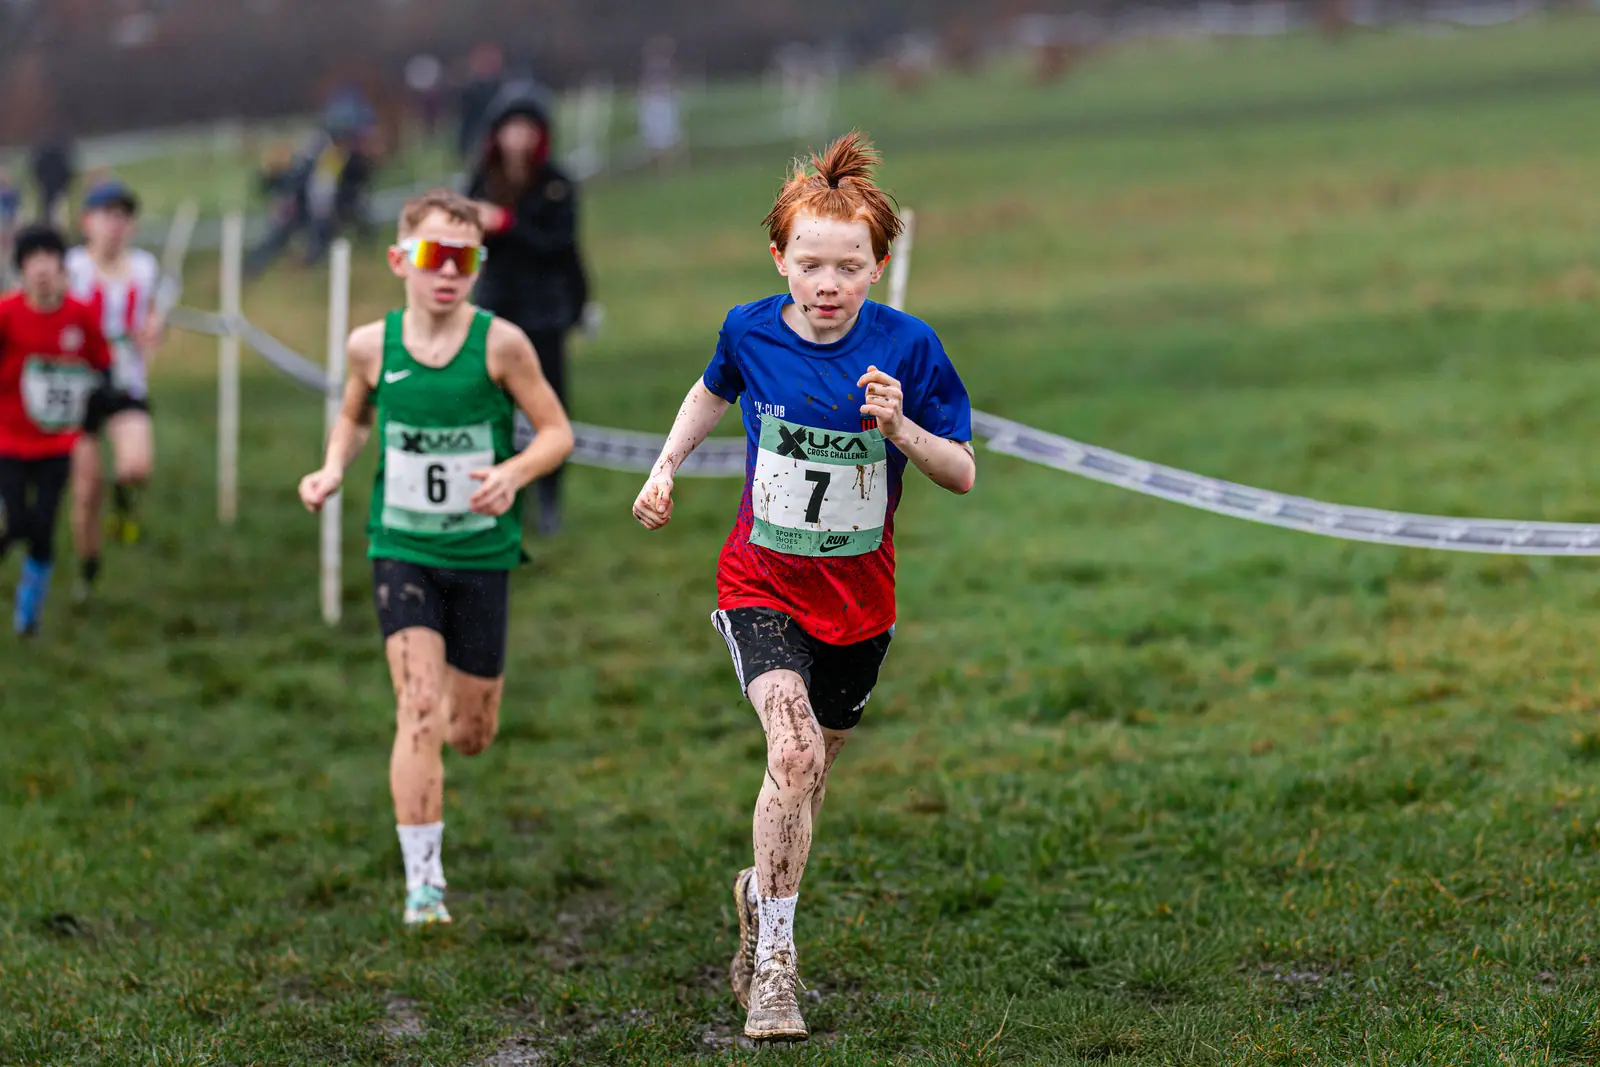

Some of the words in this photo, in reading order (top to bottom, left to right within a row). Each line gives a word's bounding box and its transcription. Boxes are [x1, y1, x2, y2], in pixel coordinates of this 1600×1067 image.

[807, 447, 829, 458] CROSS
[830, 450, 868, 460] CHALLENGE
[427, 464, 447, 504] 6
[805, 470, 831, 523] 7
[775, 529, 802, 539] SPORTS
[825, 535, 850, 545] RUN
